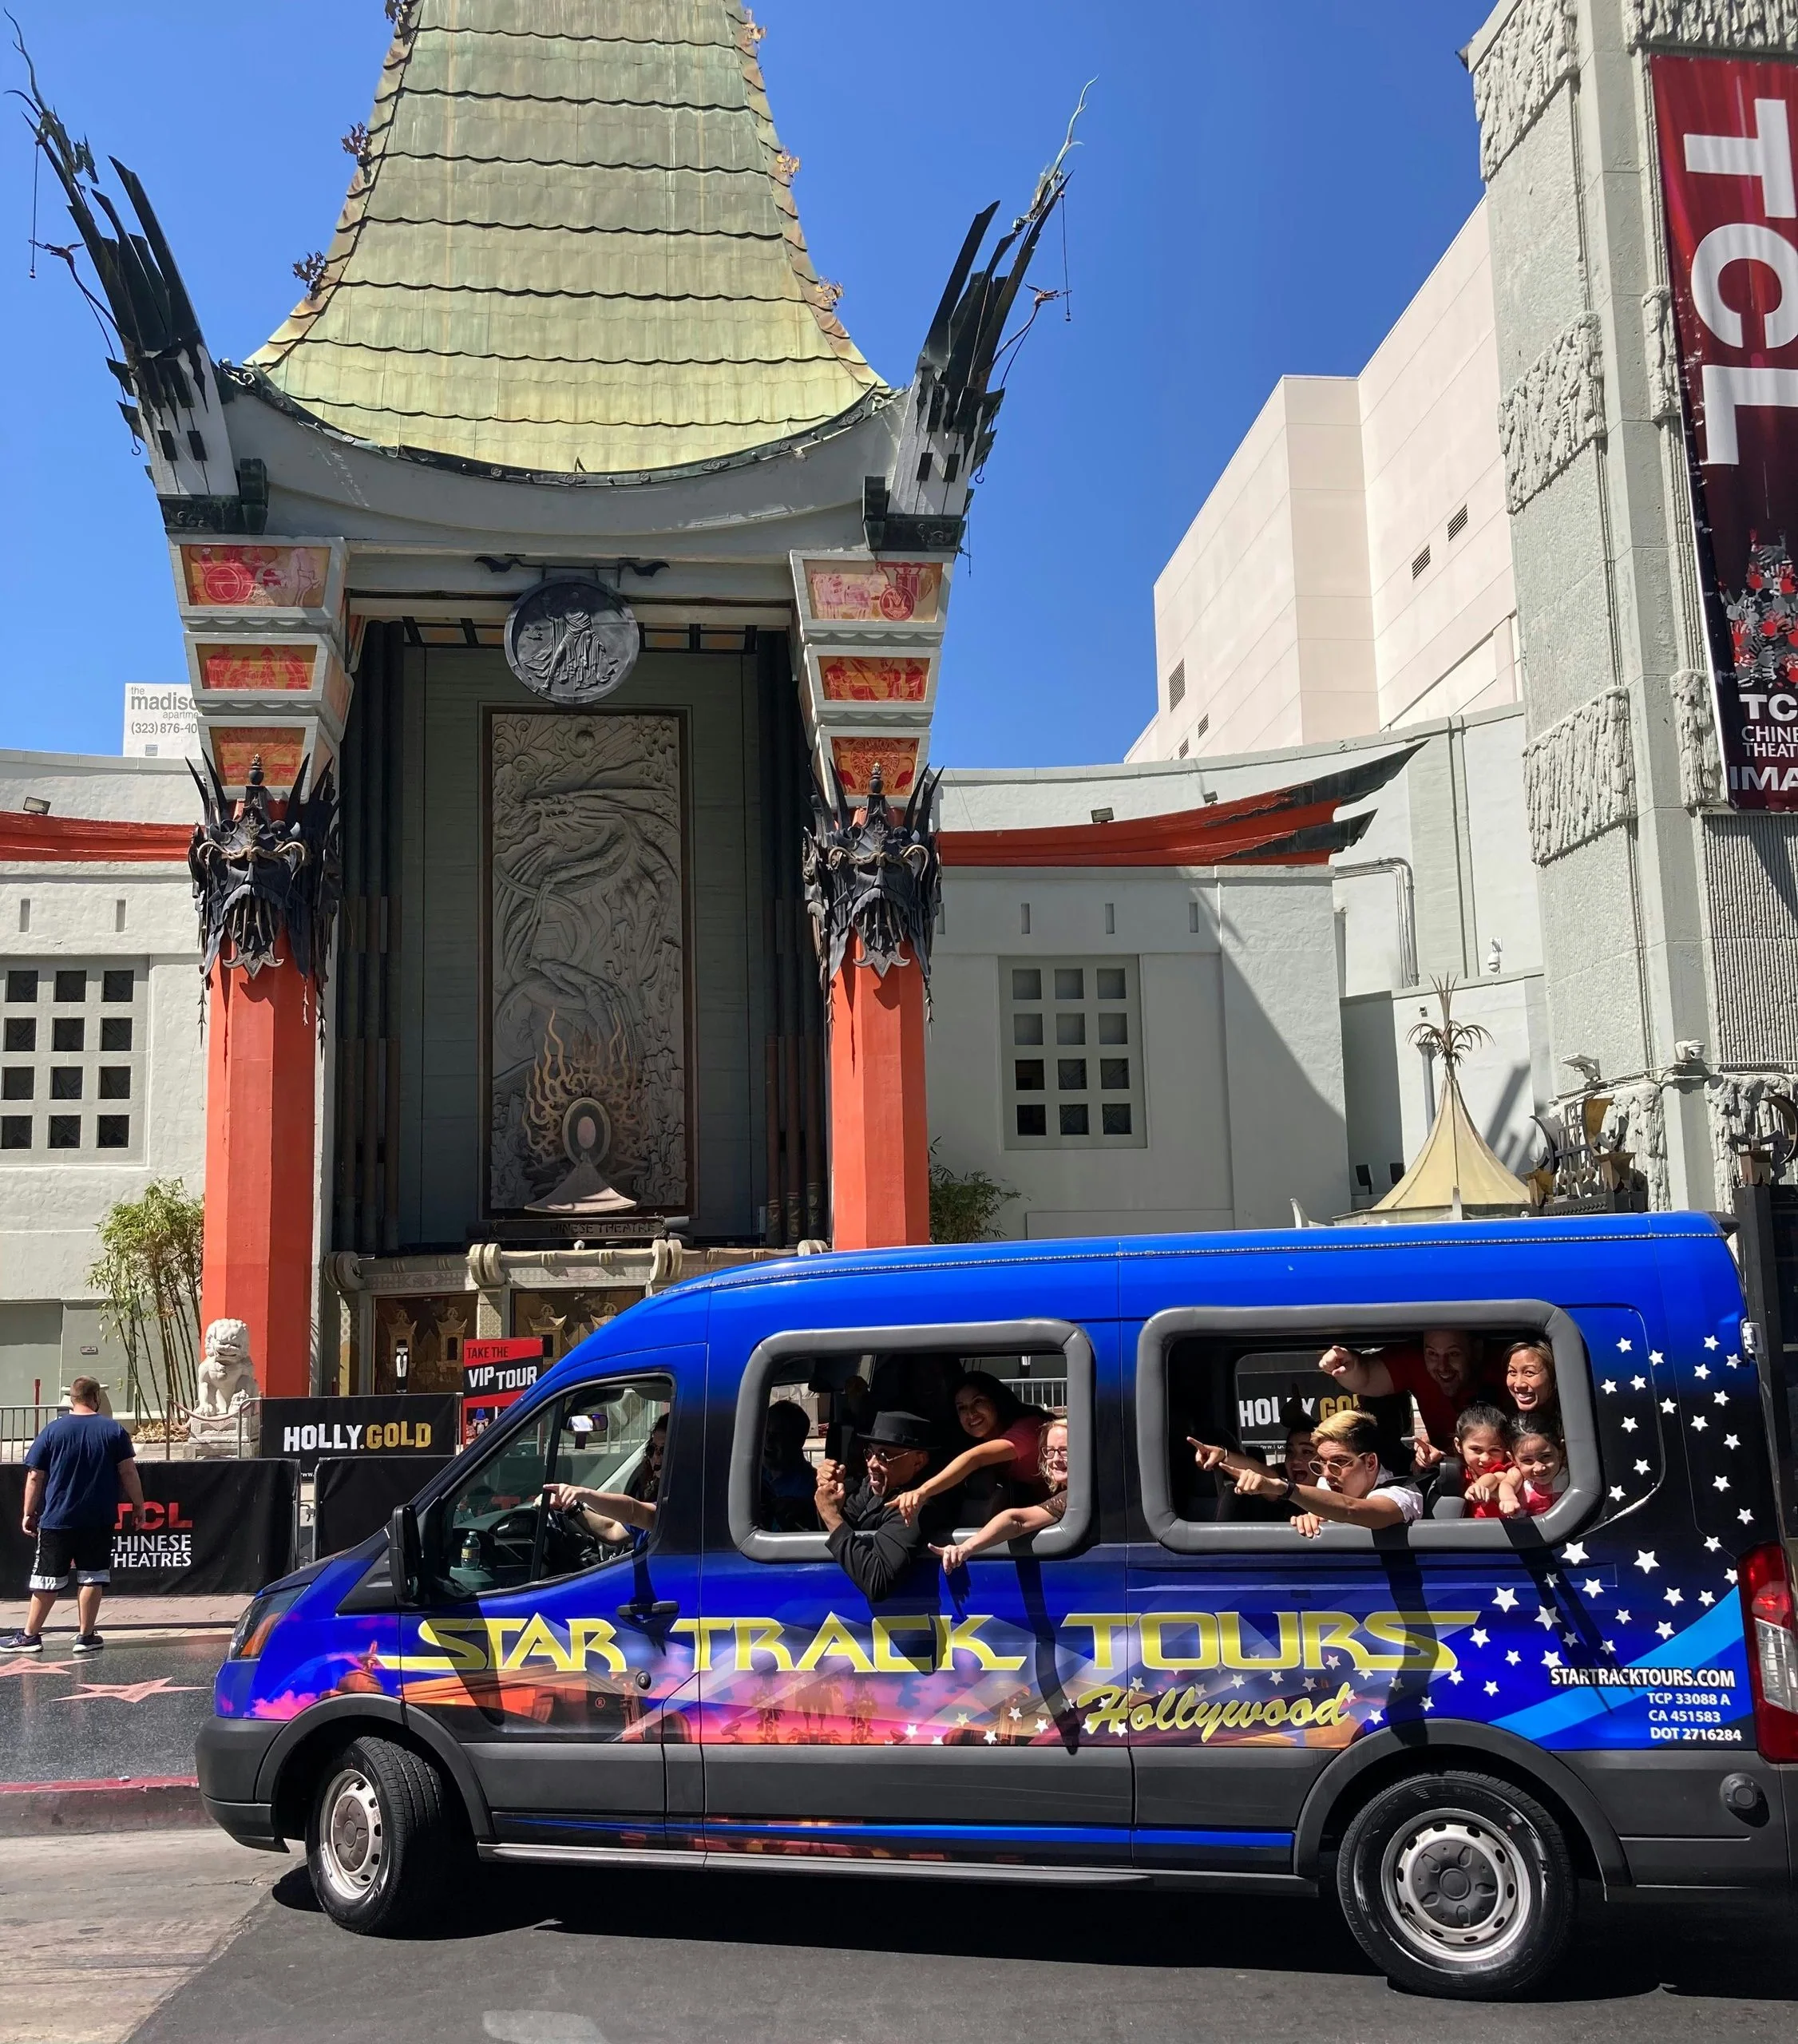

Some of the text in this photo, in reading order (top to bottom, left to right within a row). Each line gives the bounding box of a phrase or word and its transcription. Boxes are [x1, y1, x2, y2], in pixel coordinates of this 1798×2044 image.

[1684, 97, 1798, 465] TCL
[163, 711, 201, 720] apartme
[131, 722, 197, 735] (323) 876-40
[598, 1222, 655, 1234] THEATRE
[466, 1346, 509, 1359] TAKE THE
[468, 1365, 537, 1390] VIP TOUR
[283, 1420, 432, 1452] HOLLY.GOLD
[111, 1534, 192, 1552] HINESE
[110, 1551, 192, 1568] HEATRES
[376, 1610, 1482, 1674] STAR TRACK TOURS
[1550, 1667, 1736, 1688] STARTRACKTOURS.COM
[1647, 1693, 1731, 1706] TCP 33088 A
[1076, 1681, 1351, 1743] Hollywood
[1649, 1710, 1721, 1723] CA 451583
[1650, 1727, 1742, 1741] DOT 2716284
